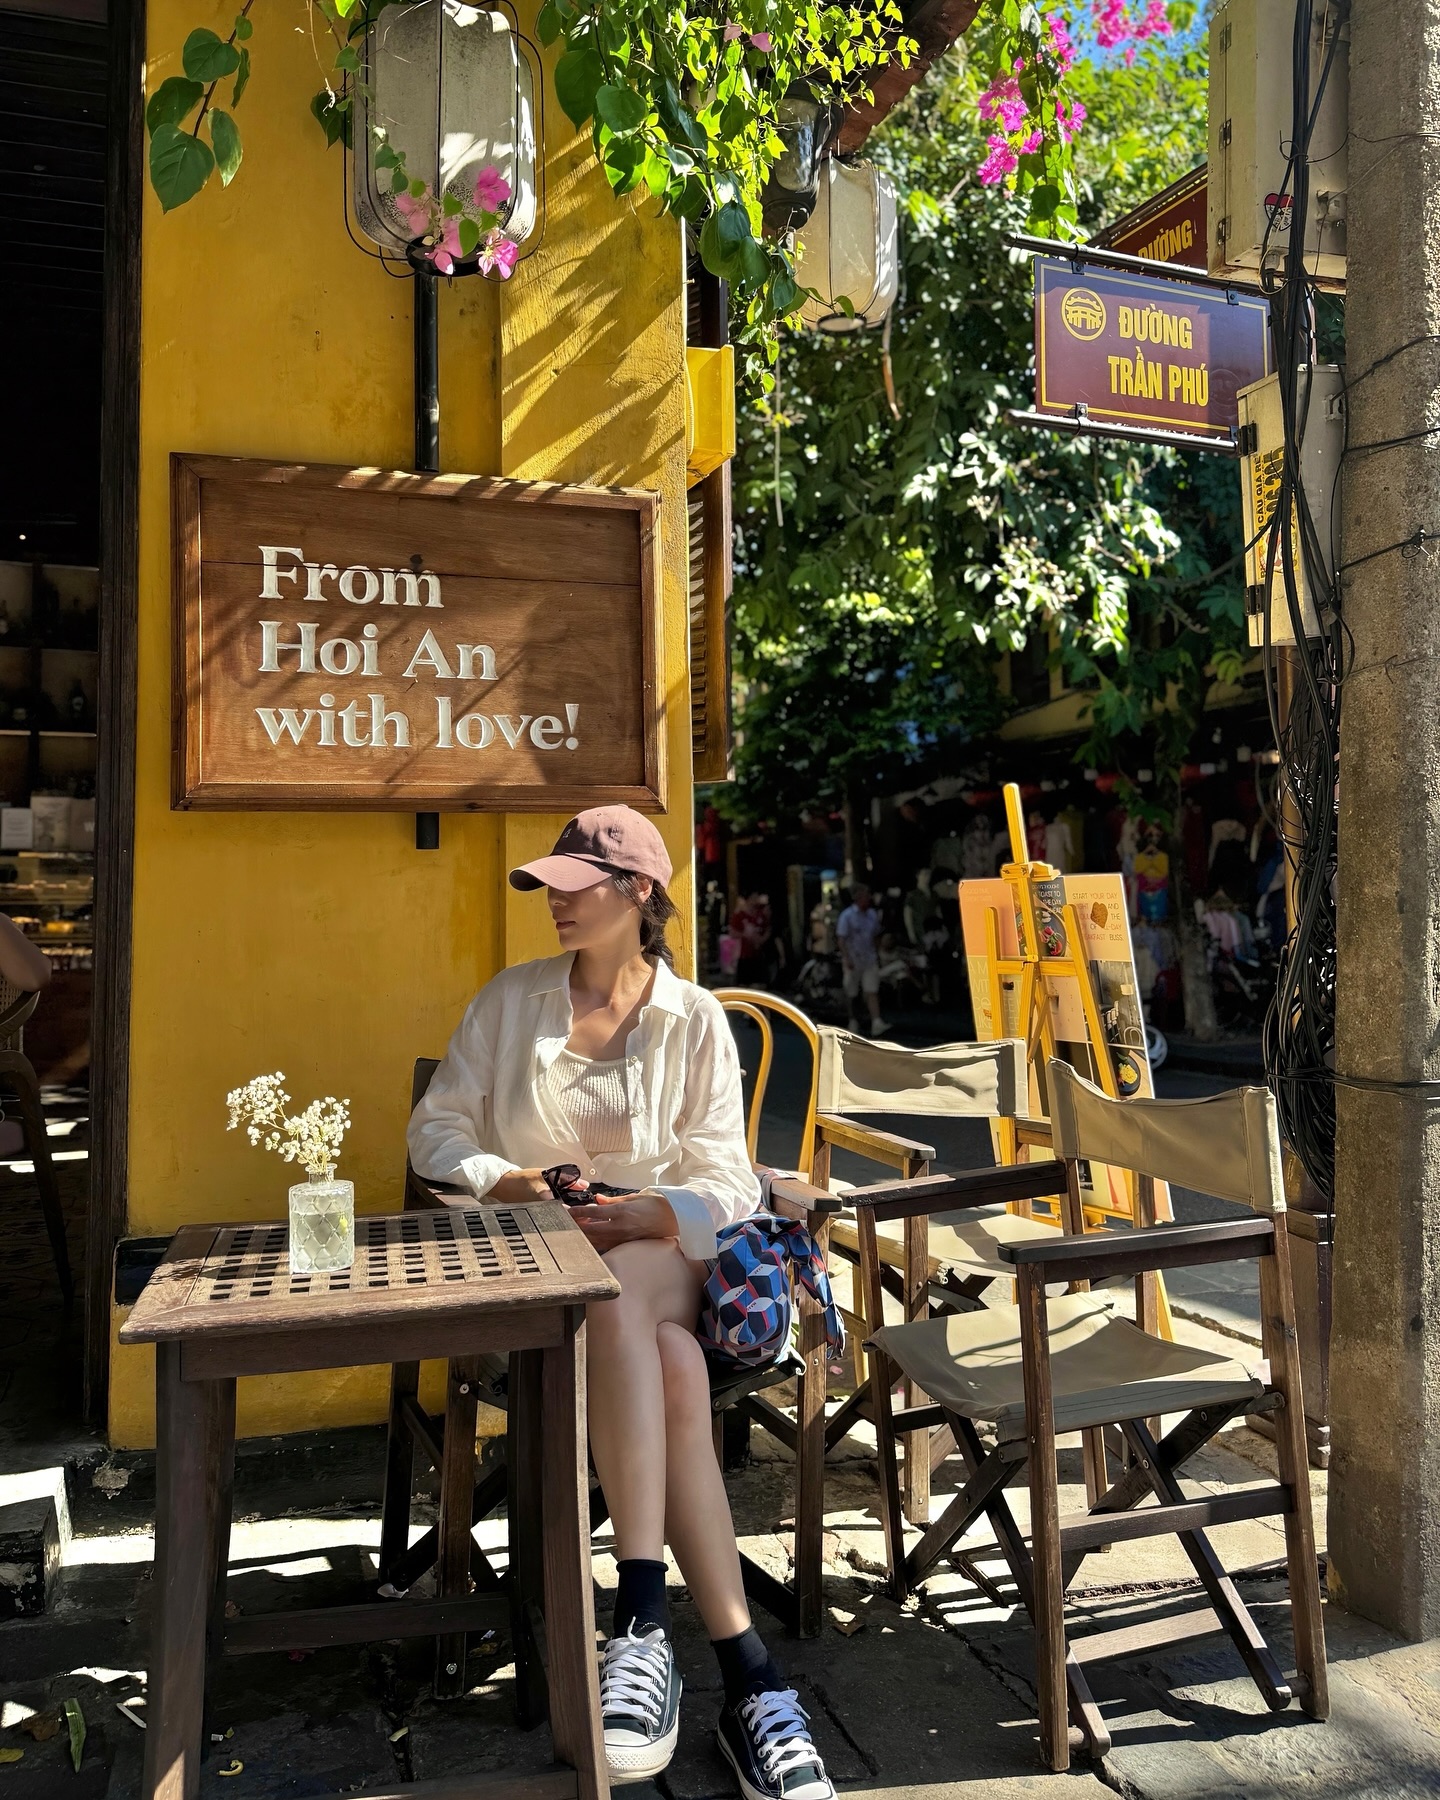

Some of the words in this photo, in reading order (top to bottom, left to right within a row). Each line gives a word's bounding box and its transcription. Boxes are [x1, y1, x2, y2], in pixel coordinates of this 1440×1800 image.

[1119, 304, 1193, 349] ĐƯỜNG
[1107, 346, 1163, 400] TRẦN
[1168, 363, 1209, 407] PHÚ
[258, 545, 444, 608] From
[258, 620, 382, 676] Hoi
[402, 628, 499, 680] An
[254, 693, 412, 747] with
[435, 696, 579, 750] love!
[1072, 892, 1088, 900] START
[1089, 892, 1105, 900] YOUR
[1106, 892, 1118, 900] DAY
[1108, 902, 1120, 910] AND
[1111, 912, 1121, 921] THE
